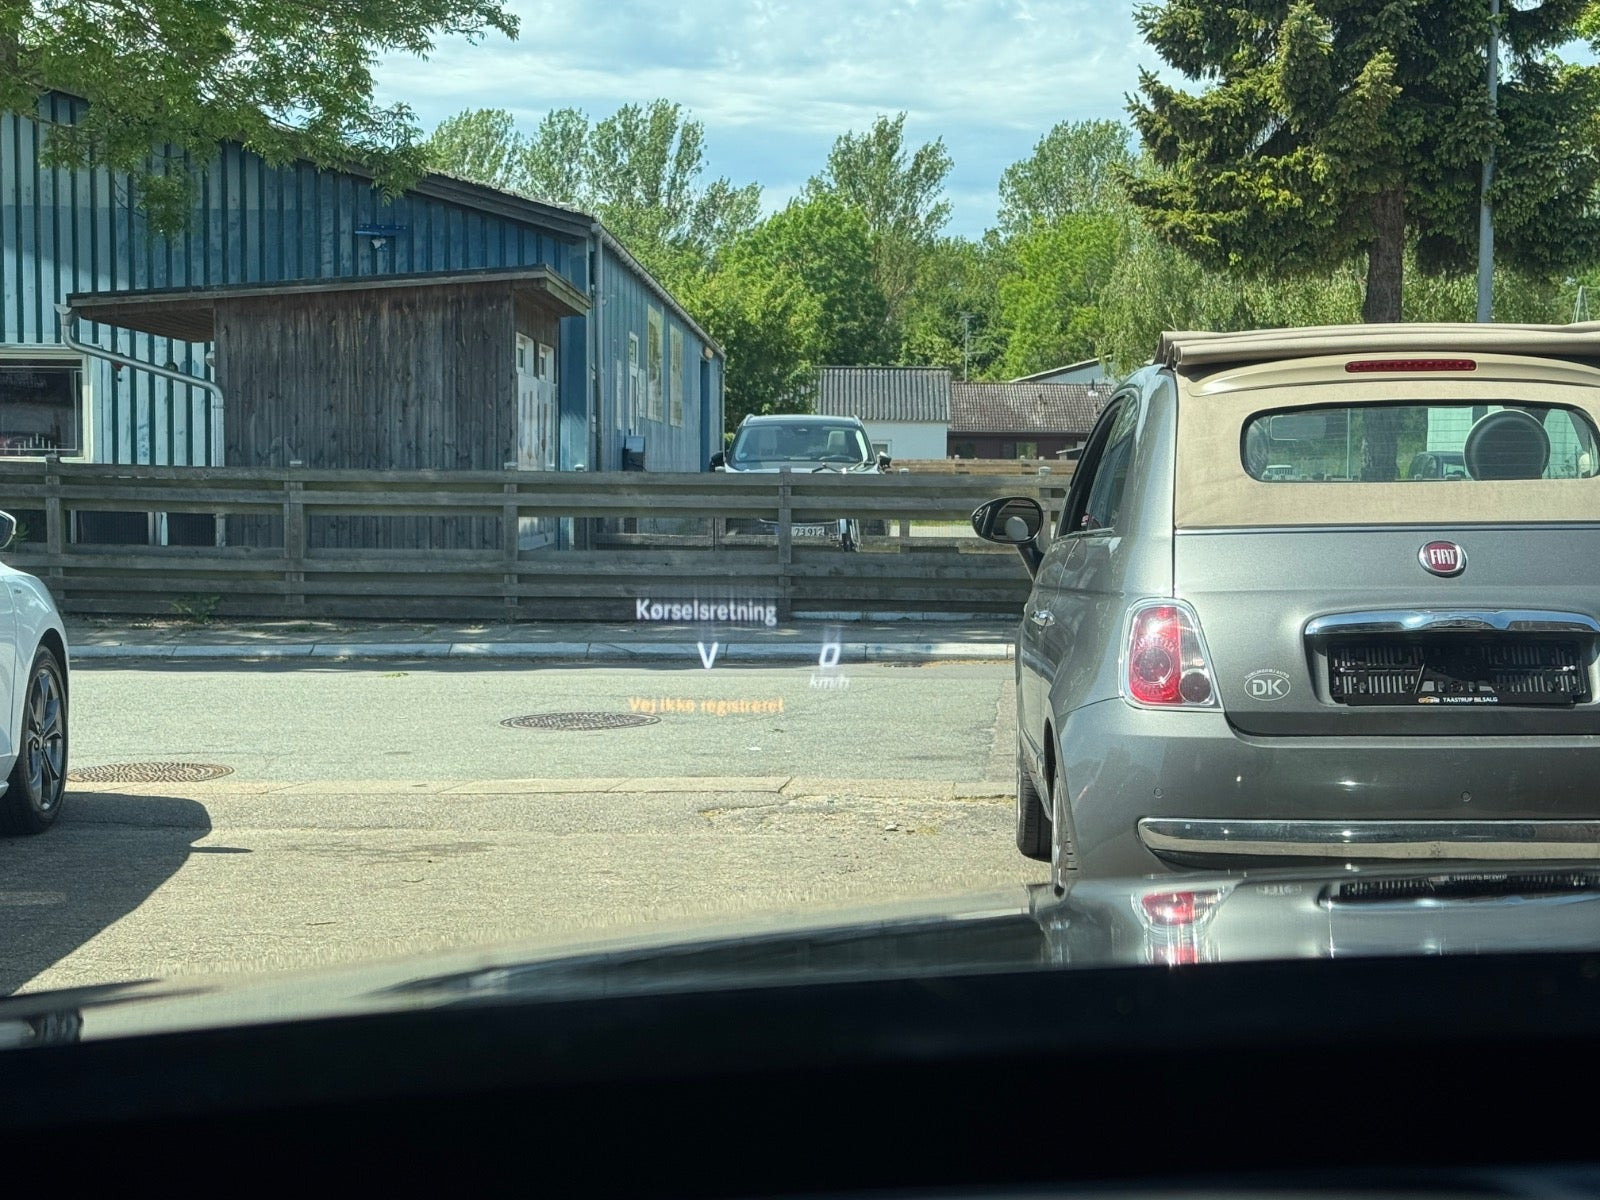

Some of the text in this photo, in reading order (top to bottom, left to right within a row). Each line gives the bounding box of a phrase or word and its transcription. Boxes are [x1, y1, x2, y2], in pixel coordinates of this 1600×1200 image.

[1430, 549, 1455, 564] FIAT
[697, 641, 719, 669] V
[818, 642, 841, 668] 0
[1252, 679, 1283, 695] DK
